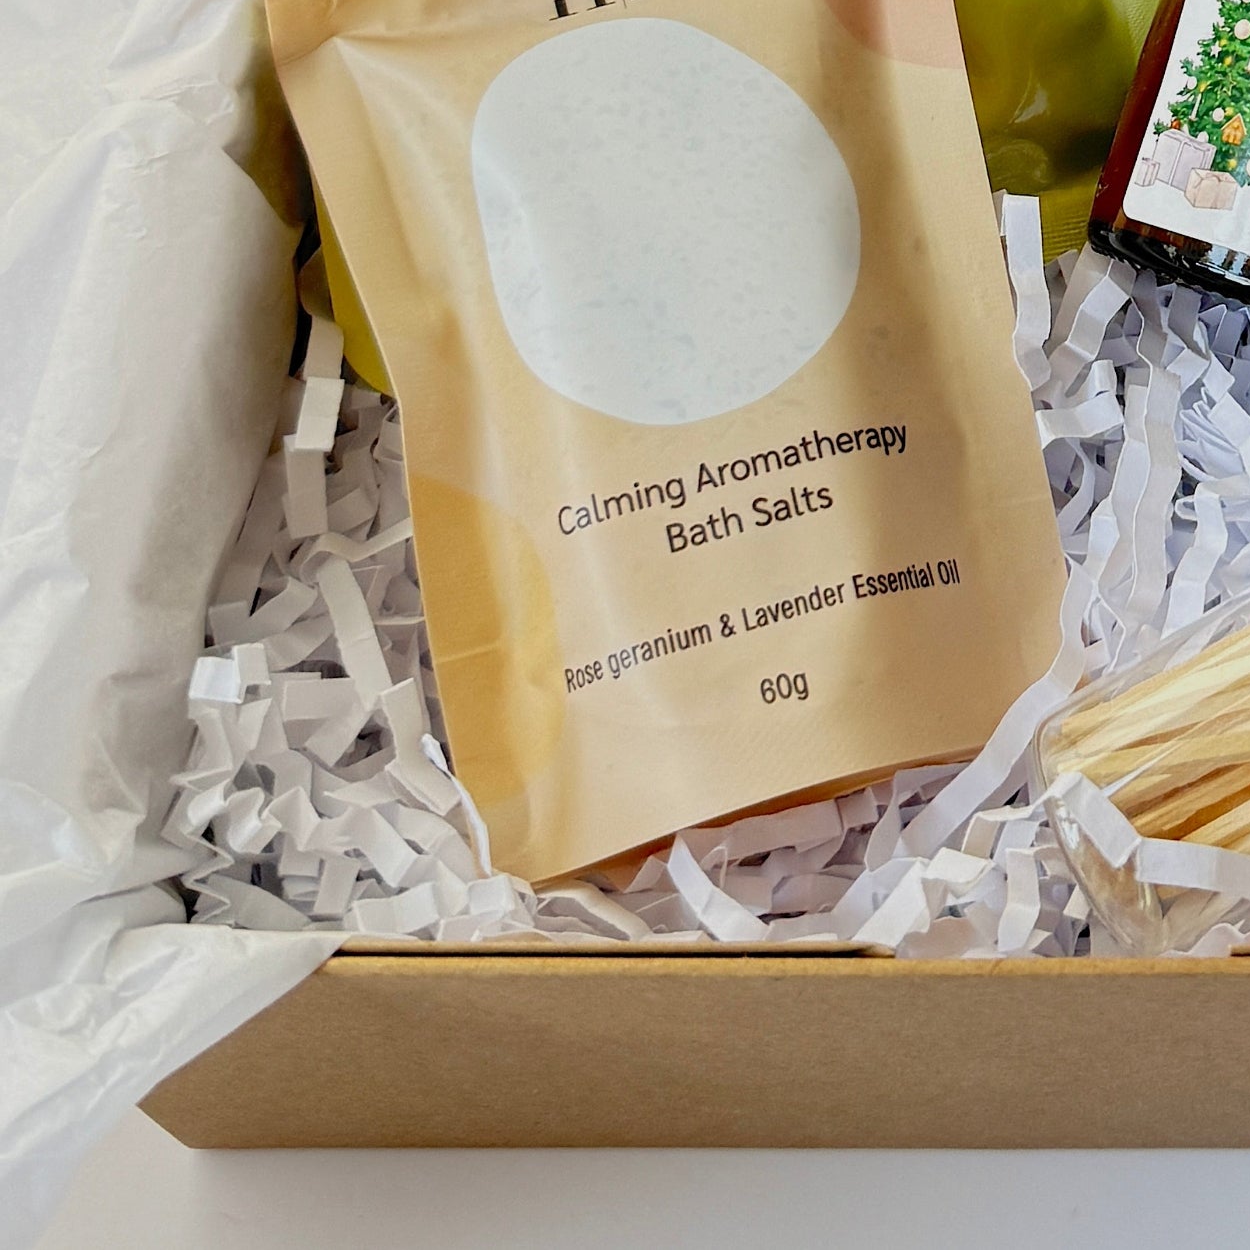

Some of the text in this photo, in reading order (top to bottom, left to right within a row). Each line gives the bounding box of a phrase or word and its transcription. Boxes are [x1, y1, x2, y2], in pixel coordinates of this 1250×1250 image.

[557, 422, 908, 536] Calming Aromatherapy
[665, 483, 834, 553] Bath Salts
[563, 559, 961, 693] Rose geranium & Lavender Essential Oil
[760, 671, 810, 705] 60g
